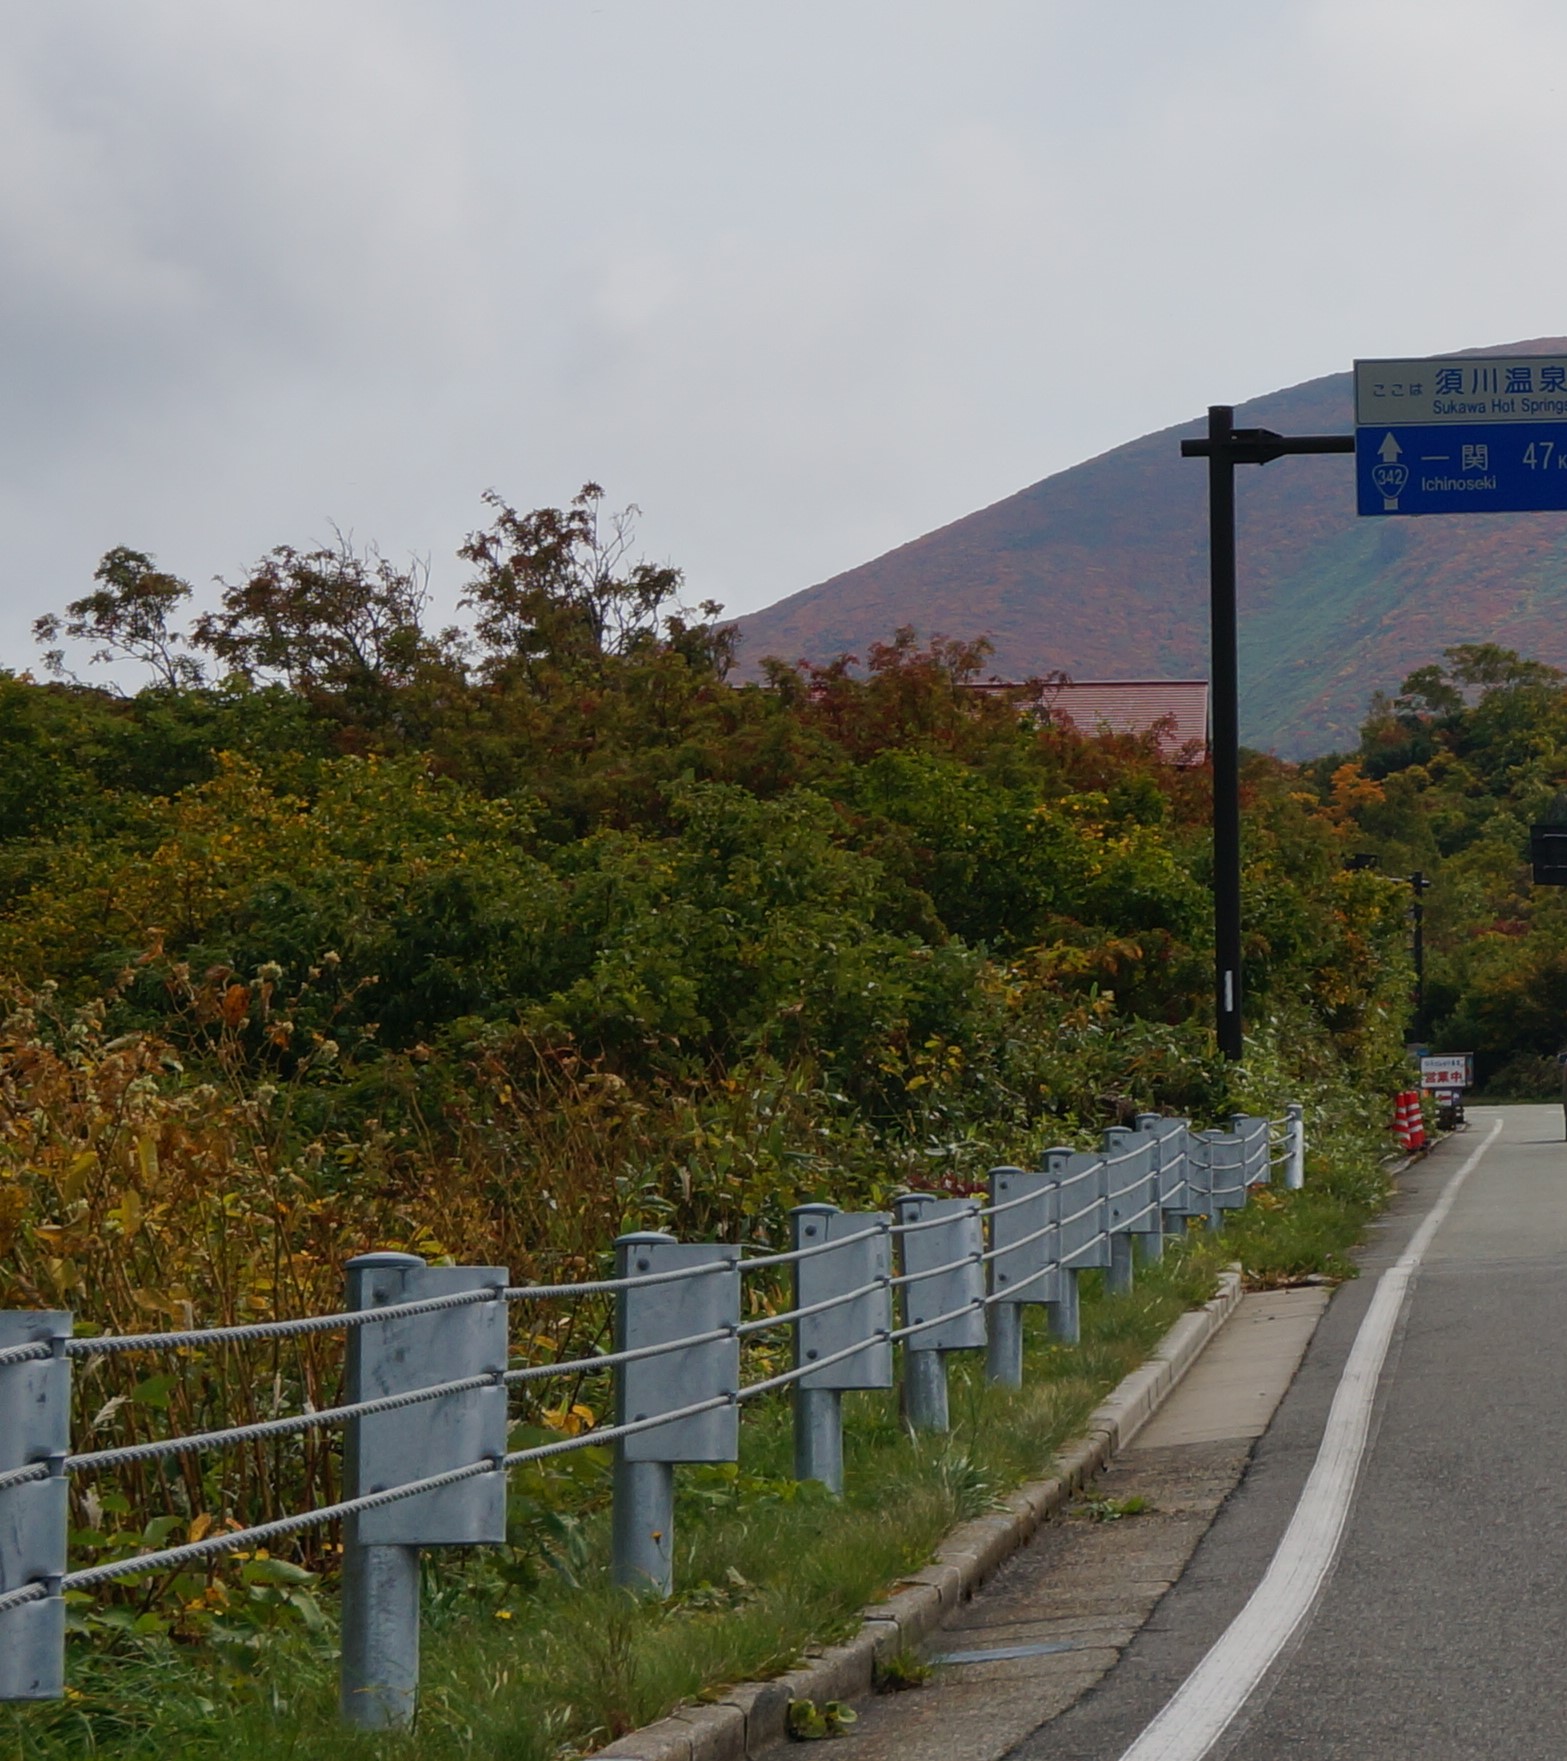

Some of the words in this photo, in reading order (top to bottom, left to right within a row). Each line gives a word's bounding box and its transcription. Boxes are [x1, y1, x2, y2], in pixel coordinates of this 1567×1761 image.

[1372, 383, 1424, 398] ここは
[1435, 366, 1567, 396] 須川温泉
[1433, 400, 1486, 415] Sukawa
[1491, 399, 1516, 414] Hot
[1420, 444, 1488, 472] 一関
[1522, 442, 1555, 470] 47
[1377, 469, 1405, 486] 342
[1421, 475, 1497, 492] Ichinoseki
